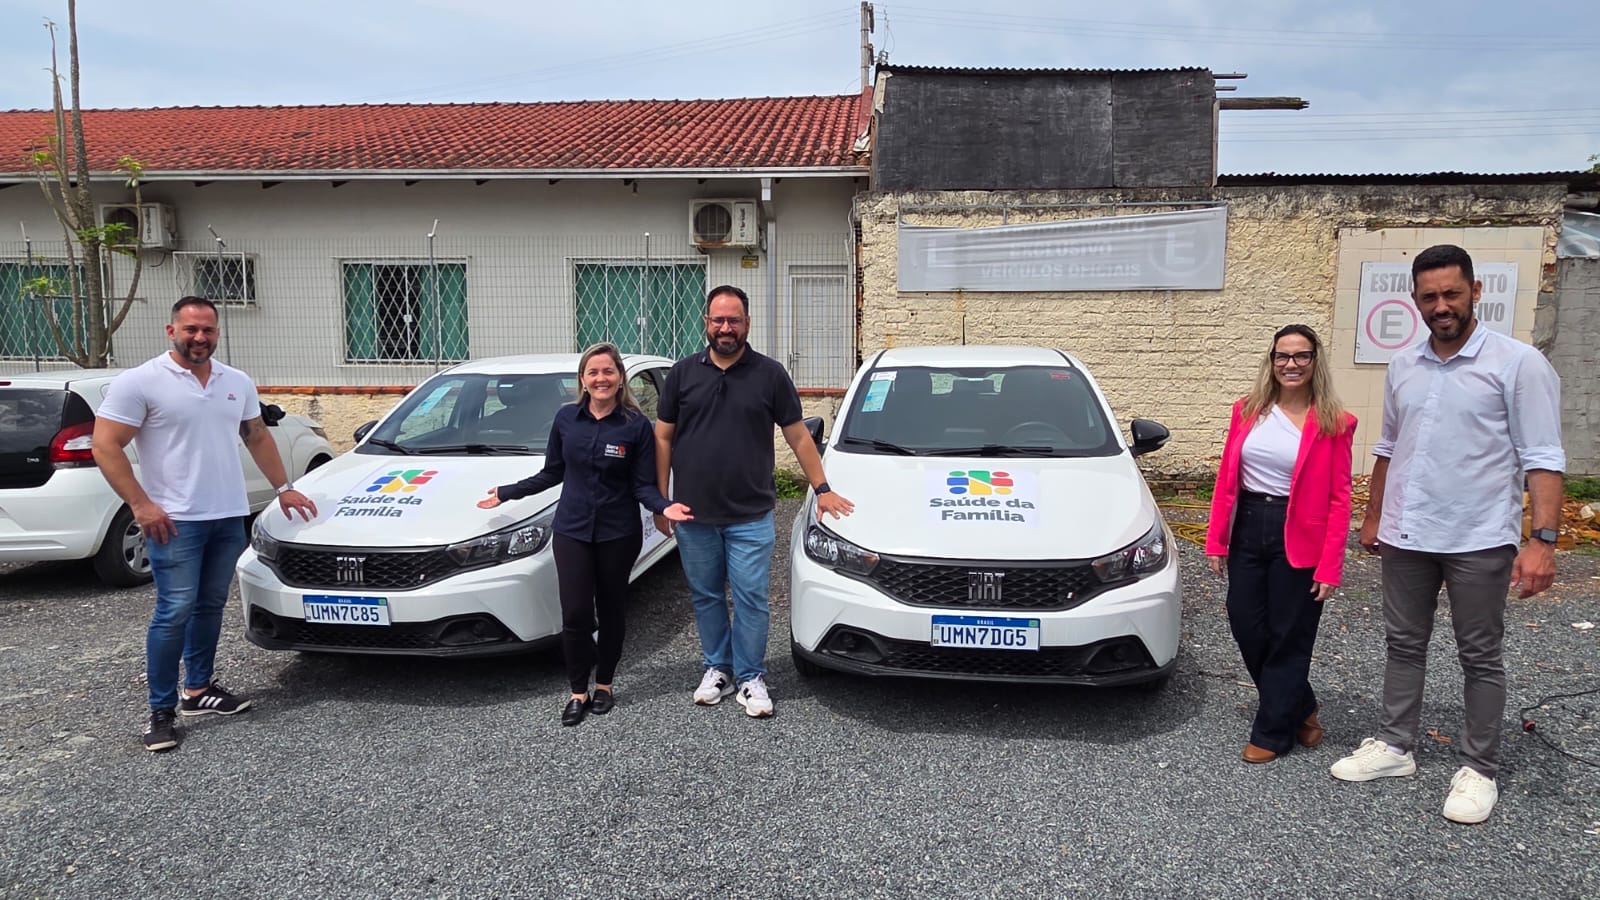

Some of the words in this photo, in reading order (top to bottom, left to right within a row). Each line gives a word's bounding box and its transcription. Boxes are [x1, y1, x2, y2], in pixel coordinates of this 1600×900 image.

[1380, 310, 1404, 339] E
[397, 496, 422, 505] da
[929, 496, 1001, 508] Saúde
[1005, 498, 1035, 509] da
[941, 509, 1025, 522] Família
[336, 556, 367, 582] FIAT
[968, 571, 1005, 601] FIAT
[311, 604, 379, 622] UMN7C85
[941, 626, 1027, 646] UMN7D05
